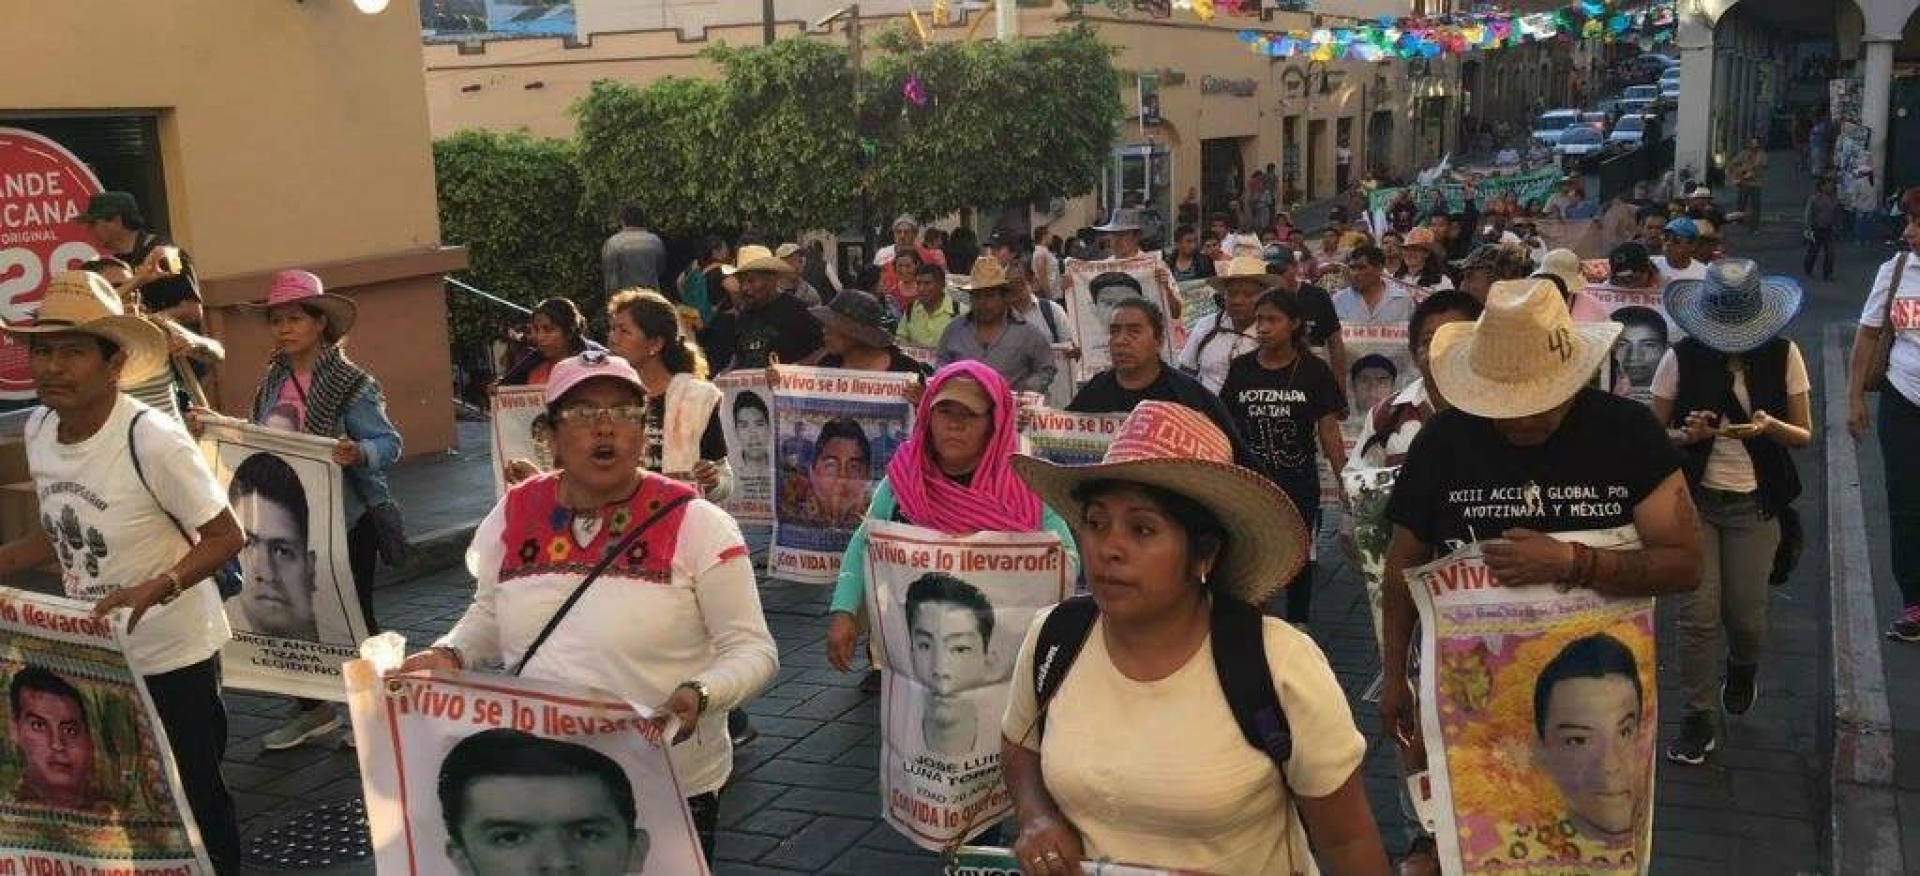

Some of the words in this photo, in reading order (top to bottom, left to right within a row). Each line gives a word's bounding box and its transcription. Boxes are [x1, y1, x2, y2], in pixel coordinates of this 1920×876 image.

[0, 171, 64, 198] NDE
[0, 199, 79, 229] CANA
[1549, 327, 1572, 363] 43
[818, 378, 834, 390] se
[836, 377, 849, 393] lo
[1079, 418, 1097, 433] se
[1100, 416, 1115, 434] lo
[1450, 489, 1484, 503] XXIII
[1547, 485, 1600, 500] GLOBAL
[1553, 503, 1563, 517] Y
[1570, 499, 1623, 517] MÉXICO
[800, 555, 826, 571] VIDA
[910, 549, 930, 568] se
[935, 548, 954, 571] lo
[471, 698, 504, 725] se
[510, 699, 536, 732] lo
